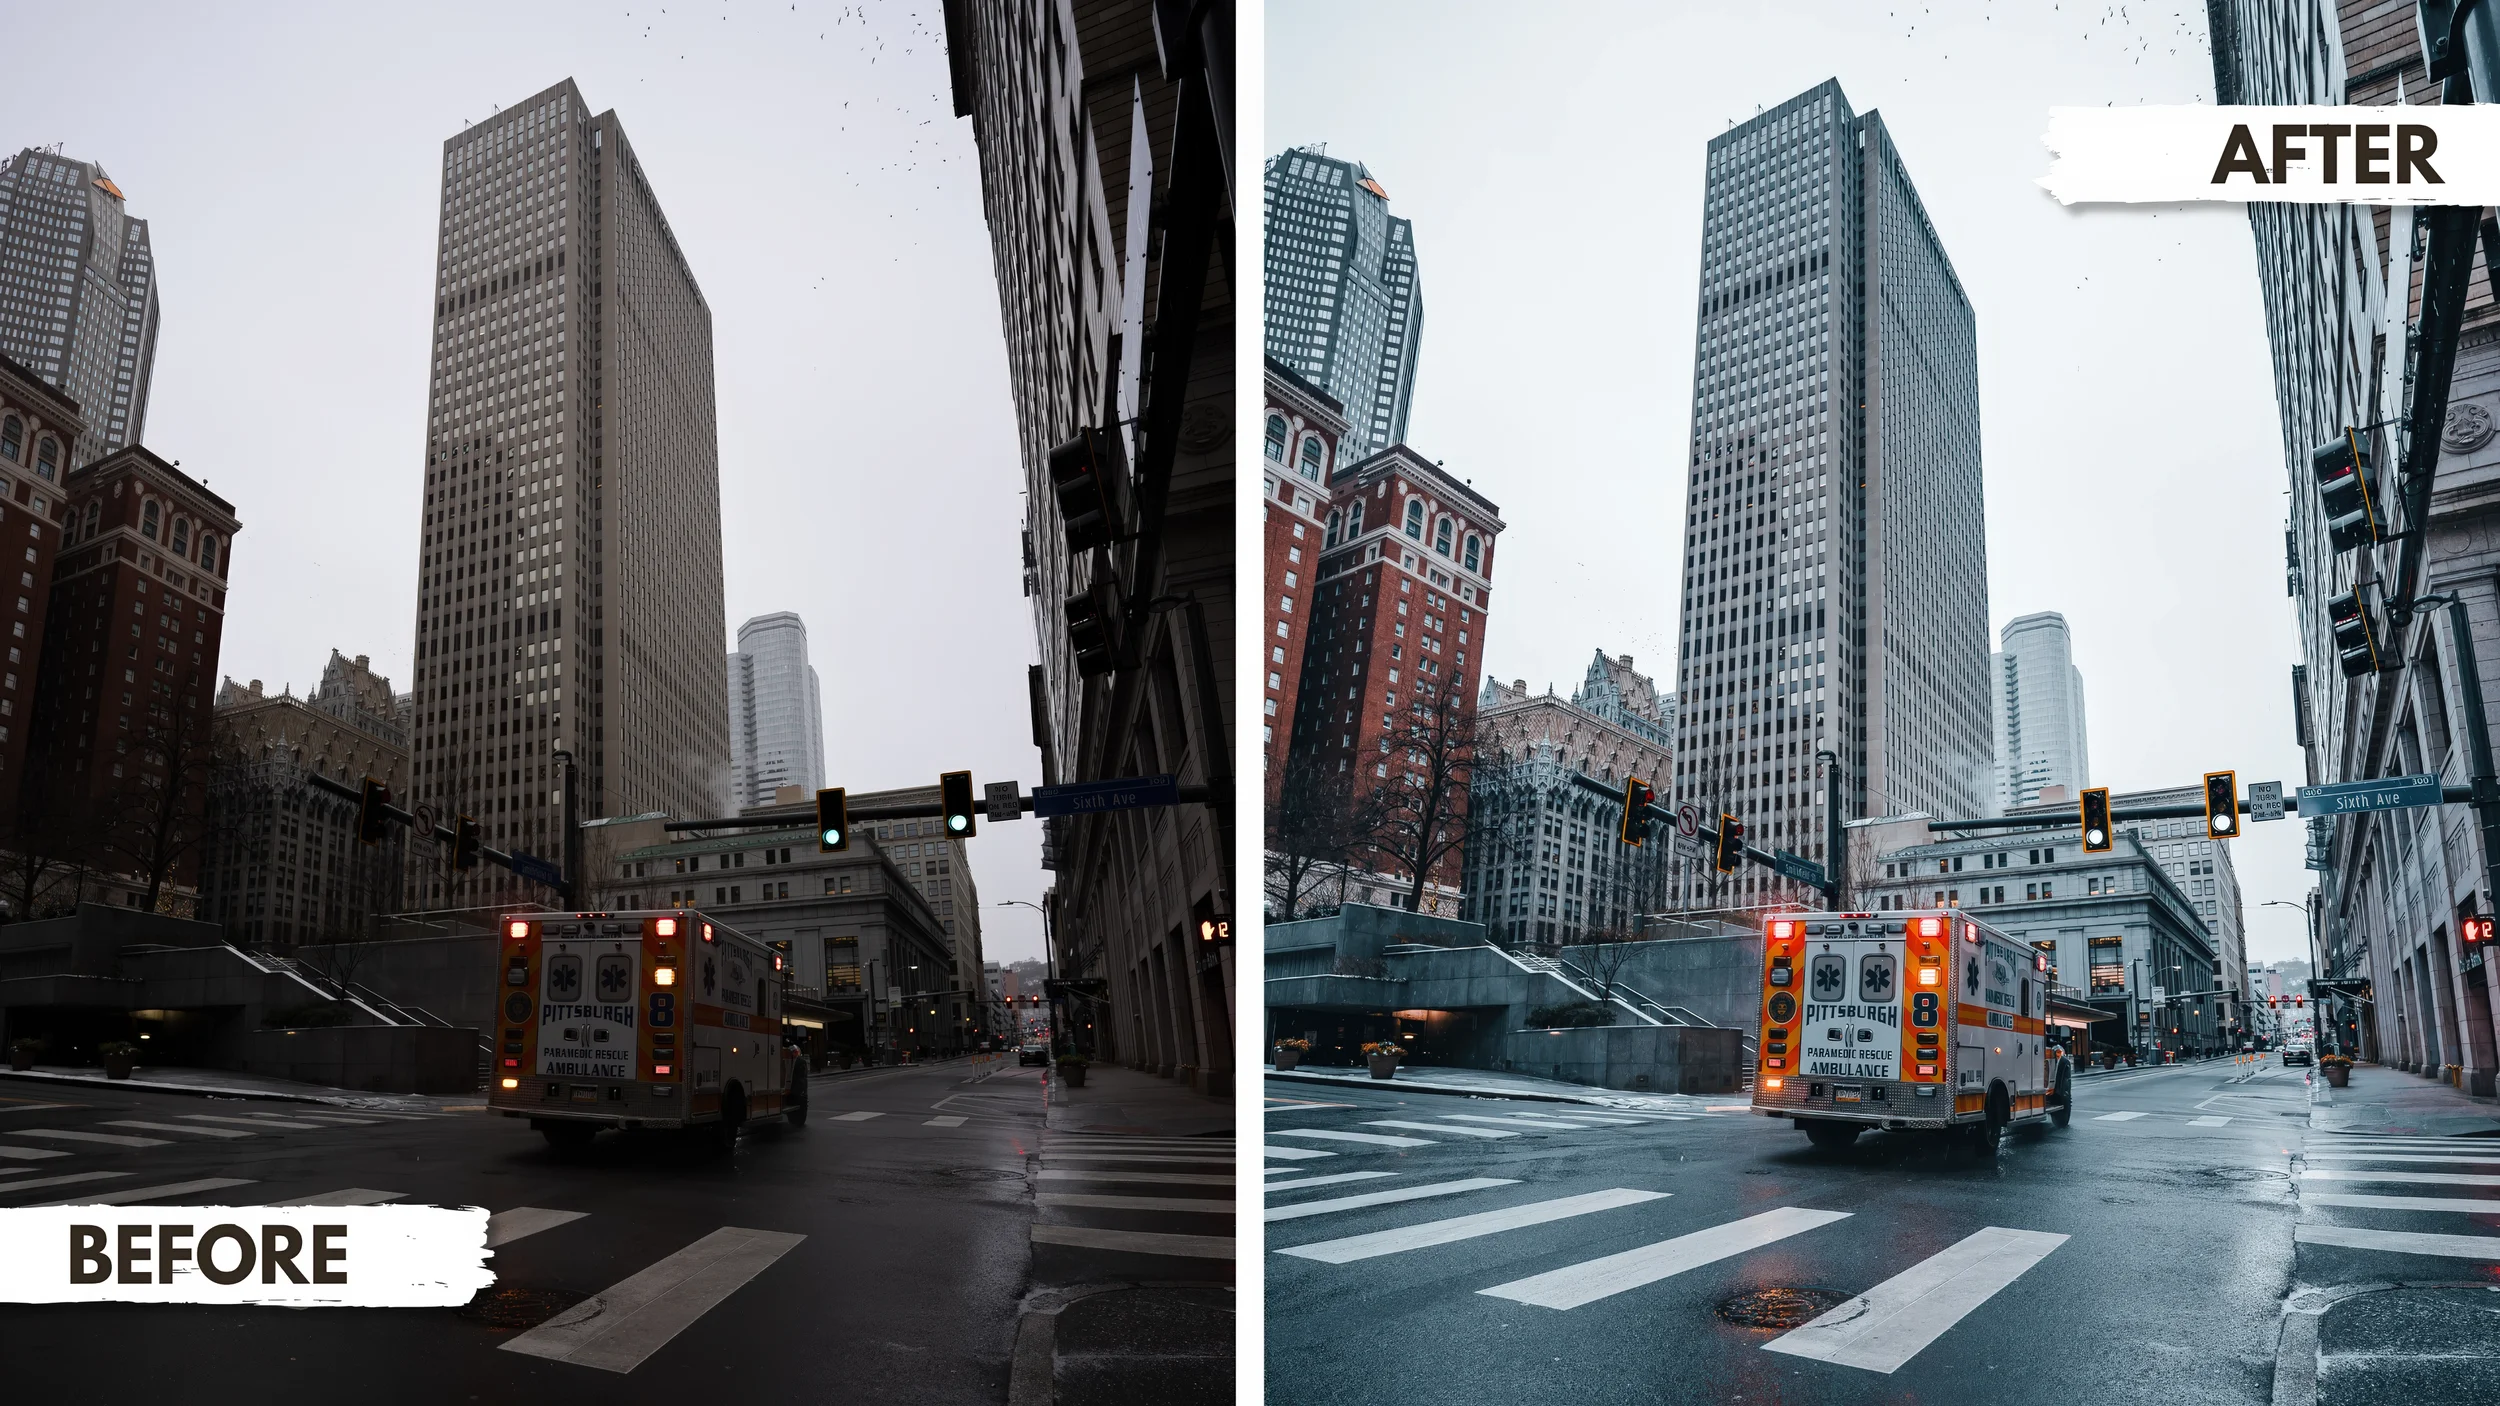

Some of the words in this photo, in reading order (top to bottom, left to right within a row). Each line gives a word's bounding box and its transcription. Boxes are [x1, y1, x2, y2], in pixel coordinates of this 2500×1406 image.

[2258, 785, 2272, 793] NO
[1072, 794, 1106, 810] Sixth
[1113, 793, 1136, 806] Ave
[2252, 803, 2263, 811] ON
[2336, 794, 2370, 810] Sixth
[2376, 793, 2400, 806] Ave
[1217, 921, 1229, 938] 12
[2481, 921, 2493, 938] 12
[542, 1004, 634, 1029] PITTSBURGH
[648, 992, 675, 1028] 8
[1806, 1004, 1898, 1029] PITTSBURGH
[1911, 992, 1939, 1028] 8
[544, 1048, 593, 1060] PARAMEDIC
[595, 1050, 629, 1061] RESCUE
[1807, 1047, 1857, 1060] PARAMEDIC
[1859, 1050, 1893, 1061] RESCUE
[546, 1062, 626, 1078] AMBULANCE
[1809, 1062, 1889, 1078] AMBULANCE
